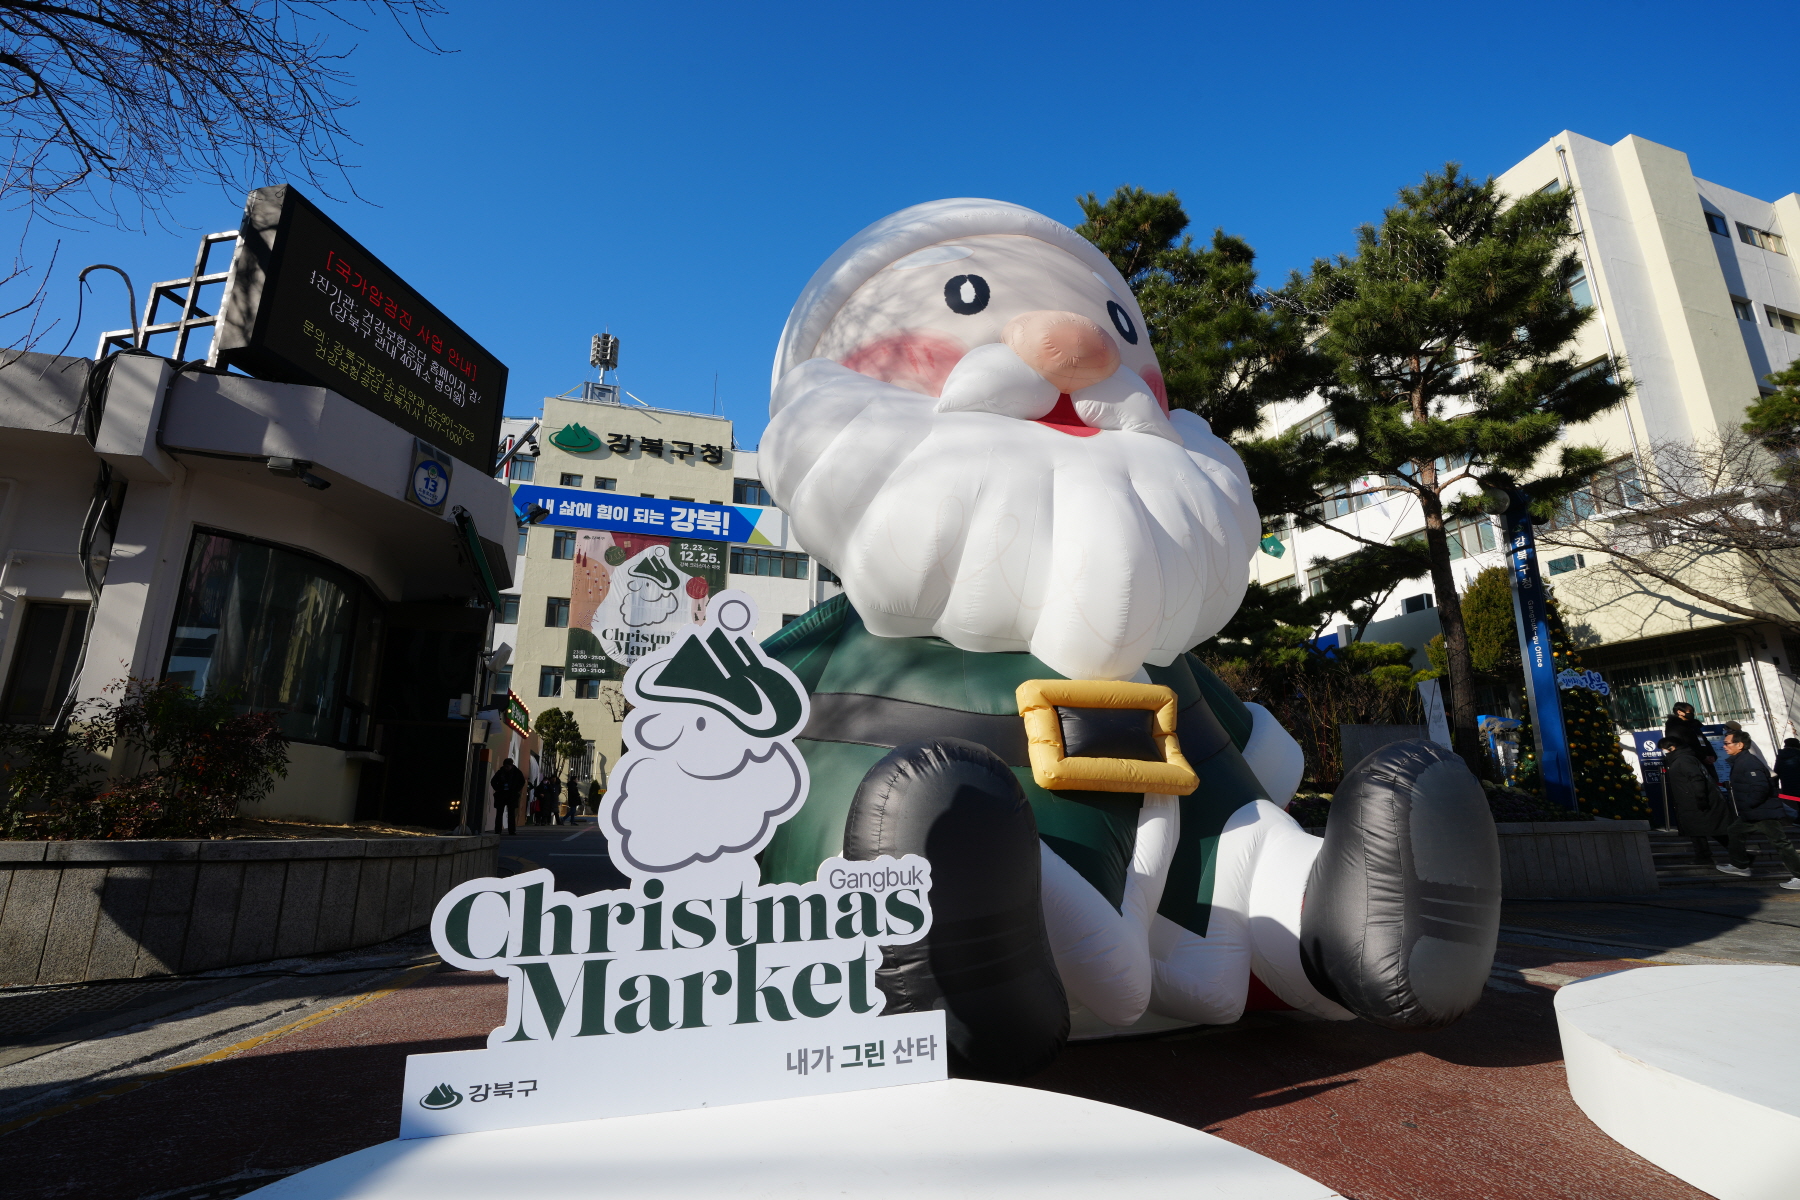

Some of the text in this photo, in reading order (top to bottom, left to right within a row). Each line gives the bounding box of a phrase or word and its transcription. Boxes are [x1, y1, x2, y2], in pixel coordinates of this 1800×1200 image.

[326, 250, 477, 382] [국가암검진 사업 안내]
[329, 301, 466, 408] (강북구 관내 40개소 병의원)
[363, 308, 427, 366] 건강보험공단
[430, 360, 466, 393] 홈페이지
[302, 319, 475, 442] 문의: 강북구보건소 의약과 02-901-7723
[315, 343, 463, 446] 건강보험공단 강북지사 1577-1000
[606, 432, 723, 464] 강북구청
[424, 477, 439, 493] 13
[537, 498, 730, 536] 내 삶에 힘이 되는 강북!
[679, 551, 721, 564] 12.25.
[680, 543, 705, 552] 12.23.
[1514, 535, 1532, 589] 강북구청
[601, 628, 671, 645] Christm
[1527, 600, 1543, 668] Gangbuk-gu Office
[829, 867, 924, 893] Gangbuk
[444, 877, 926, 961] Christmas
[501, 940, 880, 1043] Market
[786, 1034, 938, 1075] 내가 그린 산타
[469, 1079, 538, 1103] 강북구
